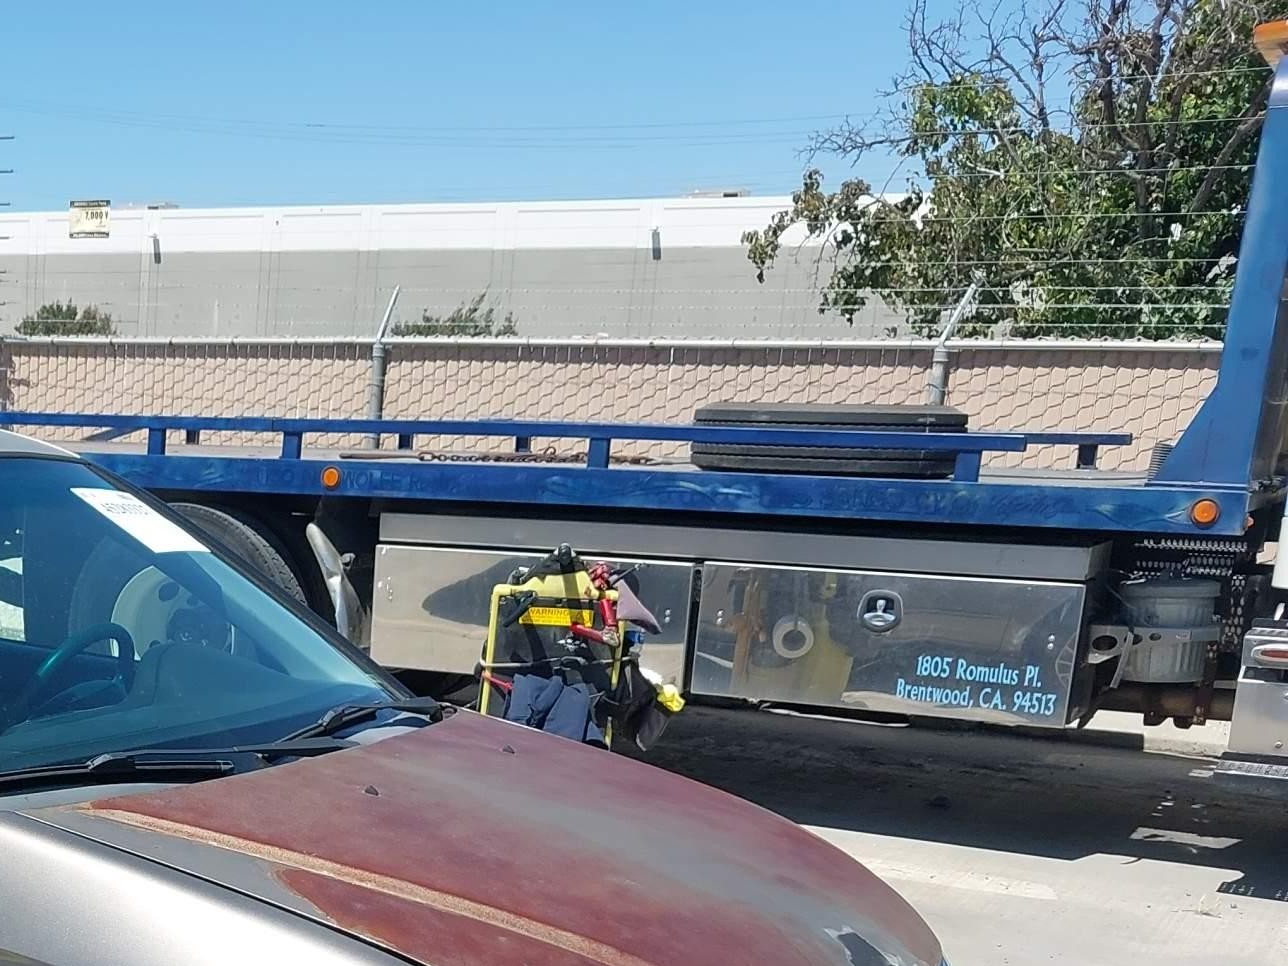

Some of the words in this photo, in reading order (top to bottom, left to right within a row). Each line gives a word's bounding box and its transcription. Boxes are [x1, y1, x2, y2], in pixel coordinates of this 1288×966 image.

[85, 211, 104, 220] 7,000
[916, 655, 952, 678] 1805
[955, 659, 1019, 686] Romulus
[1023, 665, 1042, 688] Pl.
[895, 678, 974, 709] Brentwood,
[979, 688, 1006, 710] CA.
[1012, 691, 1057, 716] 94513
